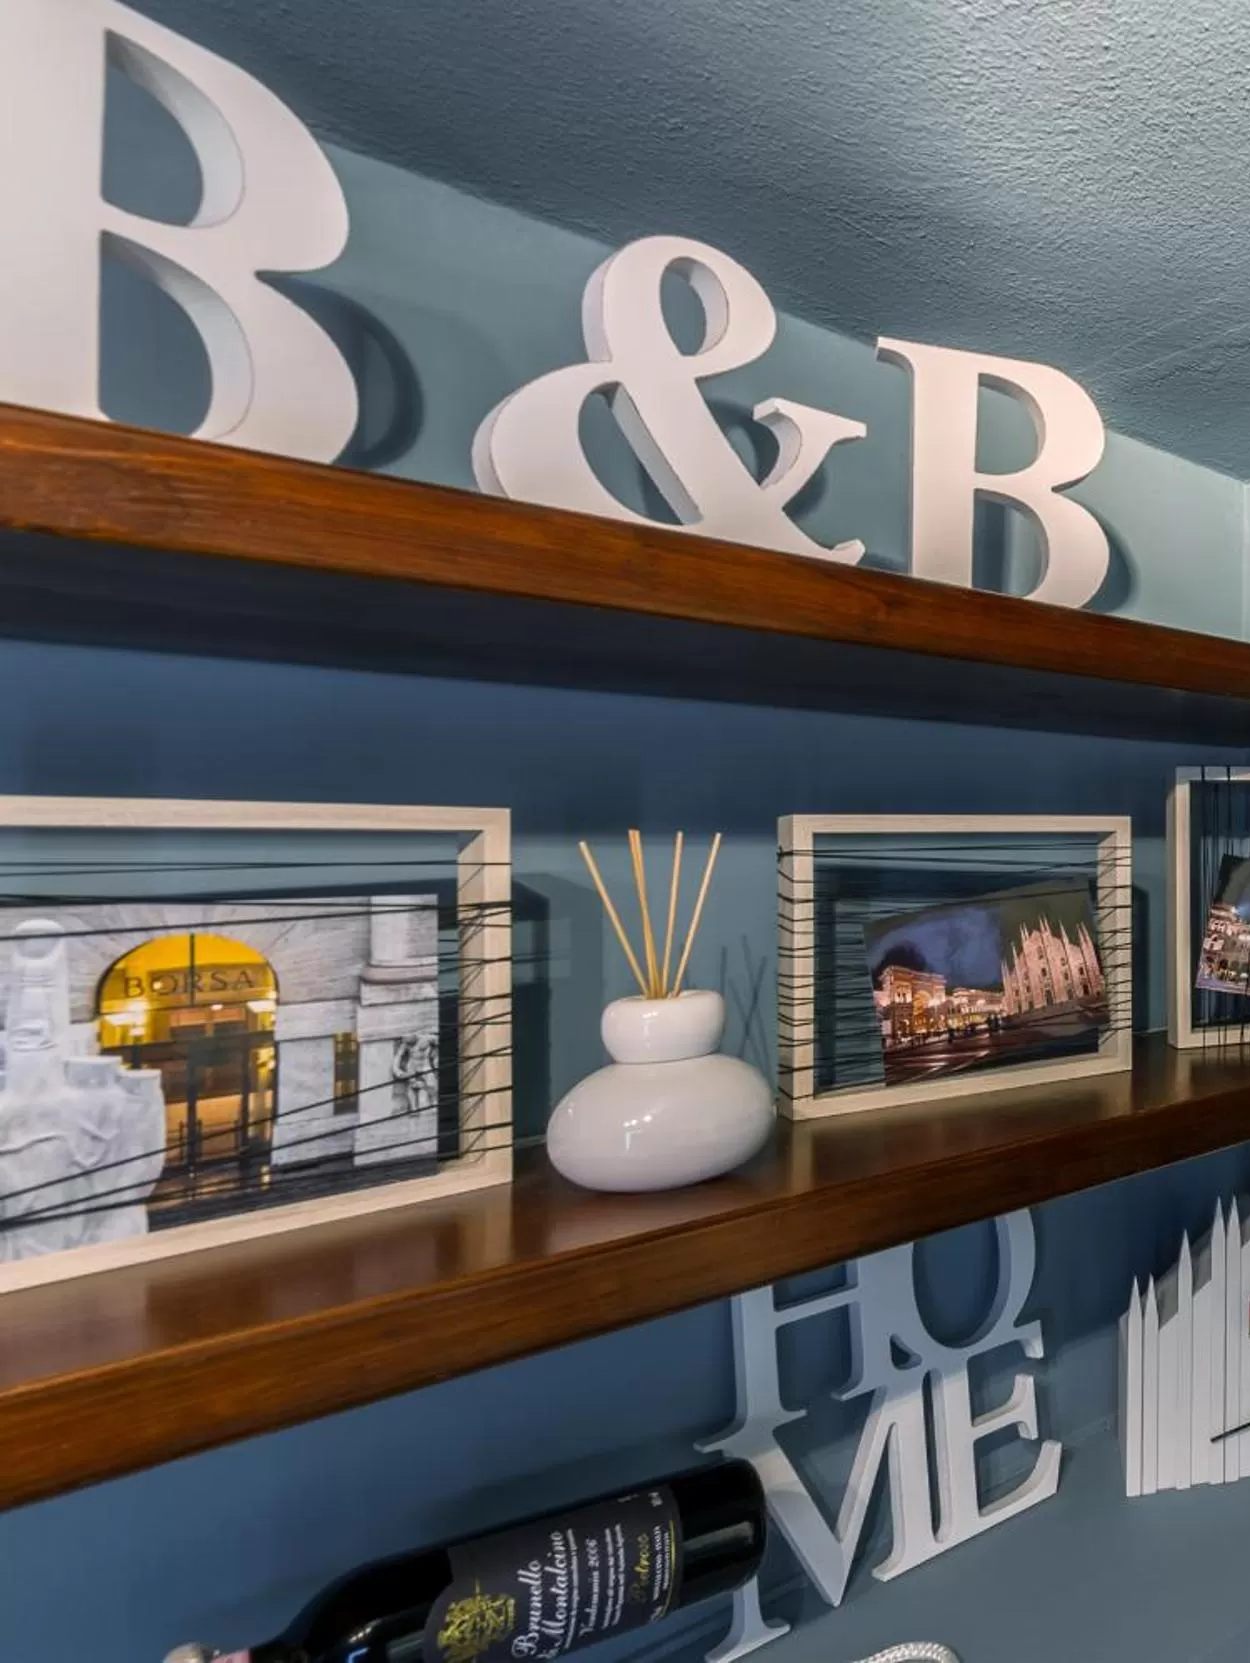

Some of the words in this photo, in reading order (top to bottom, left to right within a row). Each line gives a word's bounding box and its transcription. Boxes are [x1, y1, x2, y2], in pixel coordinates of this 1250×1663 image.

[122, 969, 255, 999] BORSA
[511, 1559, 542, 1659] Brunello
[541, 1530, 569, 1647] Montalcino
